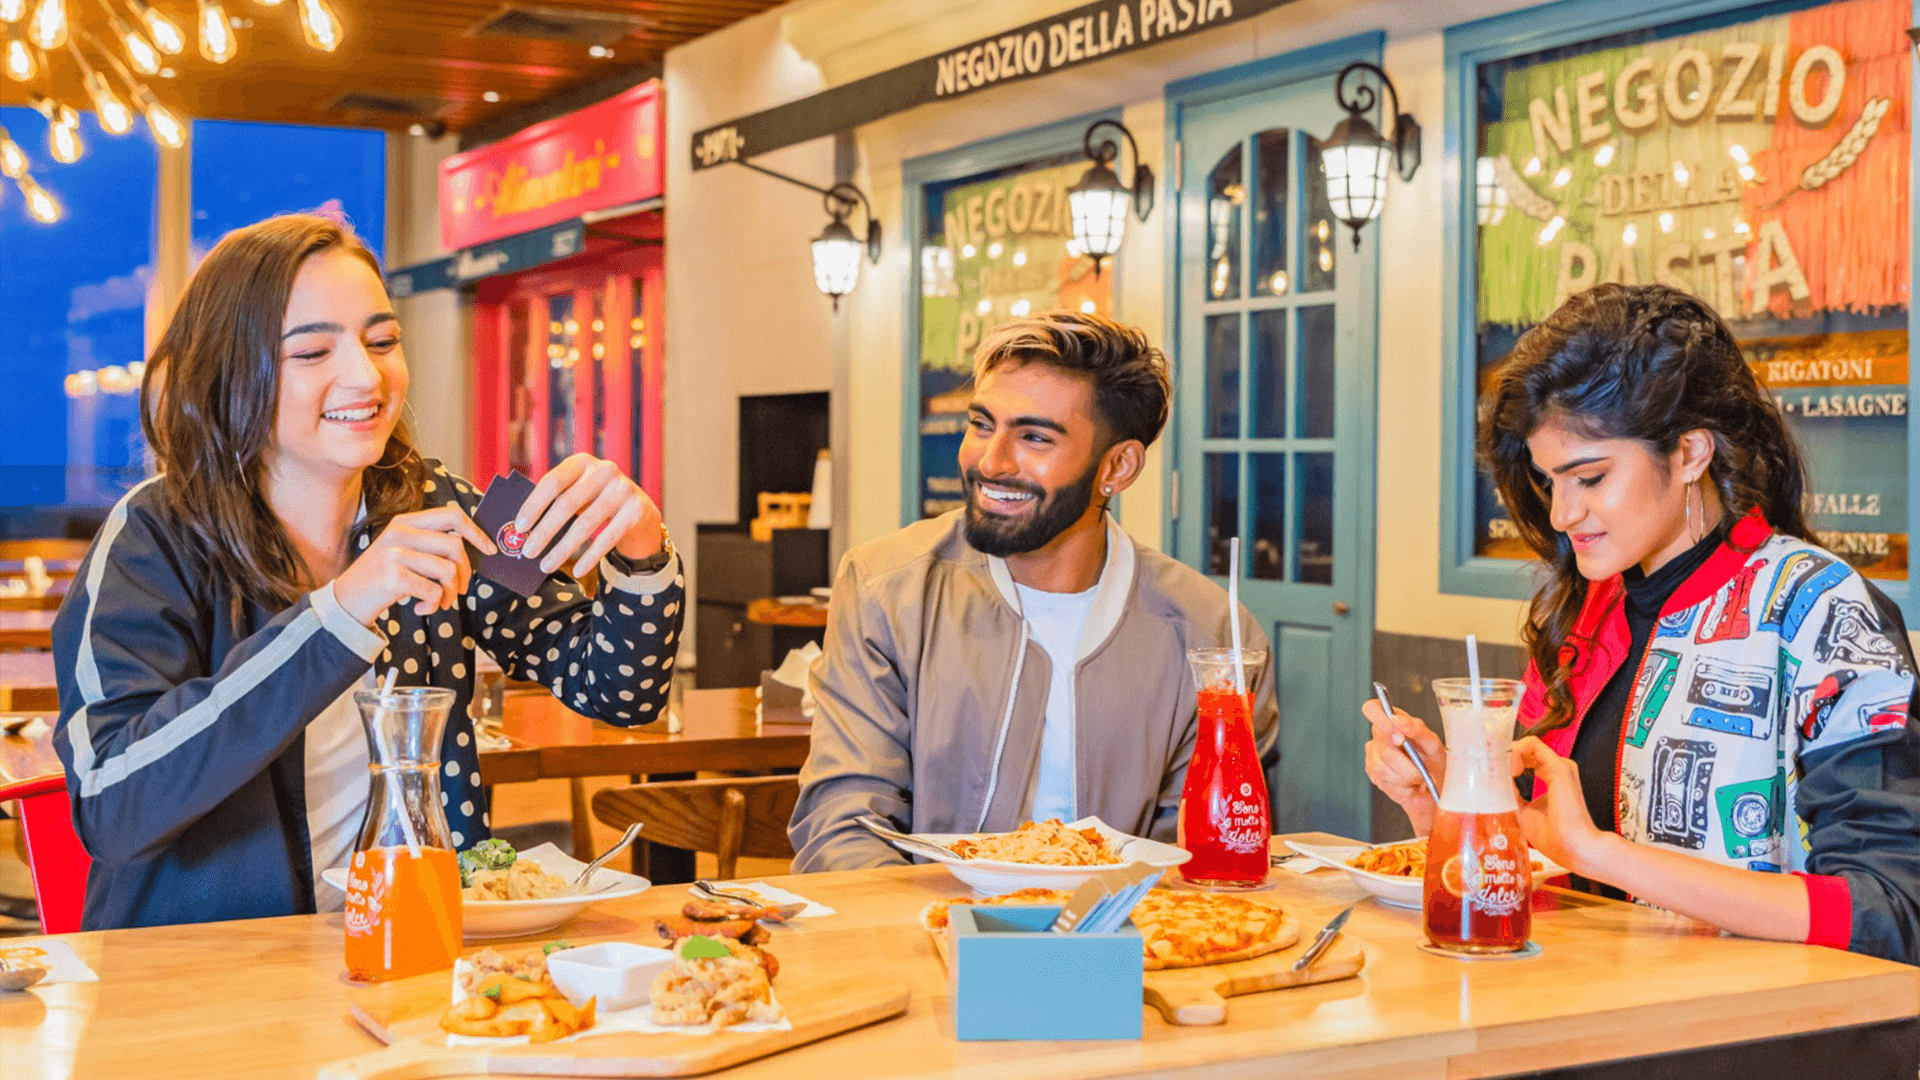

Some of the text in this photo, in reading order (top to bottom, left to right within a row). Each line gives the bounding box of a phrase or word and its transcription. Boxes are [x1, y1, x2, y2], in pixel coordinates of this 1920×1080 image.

[935, 31, 1044, 96] NEGOZIO
[1048, 4, 1134, 68] DELLA
[1528, 42, 1846, 162] NEGOZIO
[944, 180, 1073, 260] NEGOZI
[1801, 392, 1907, 418] LASAGNE
